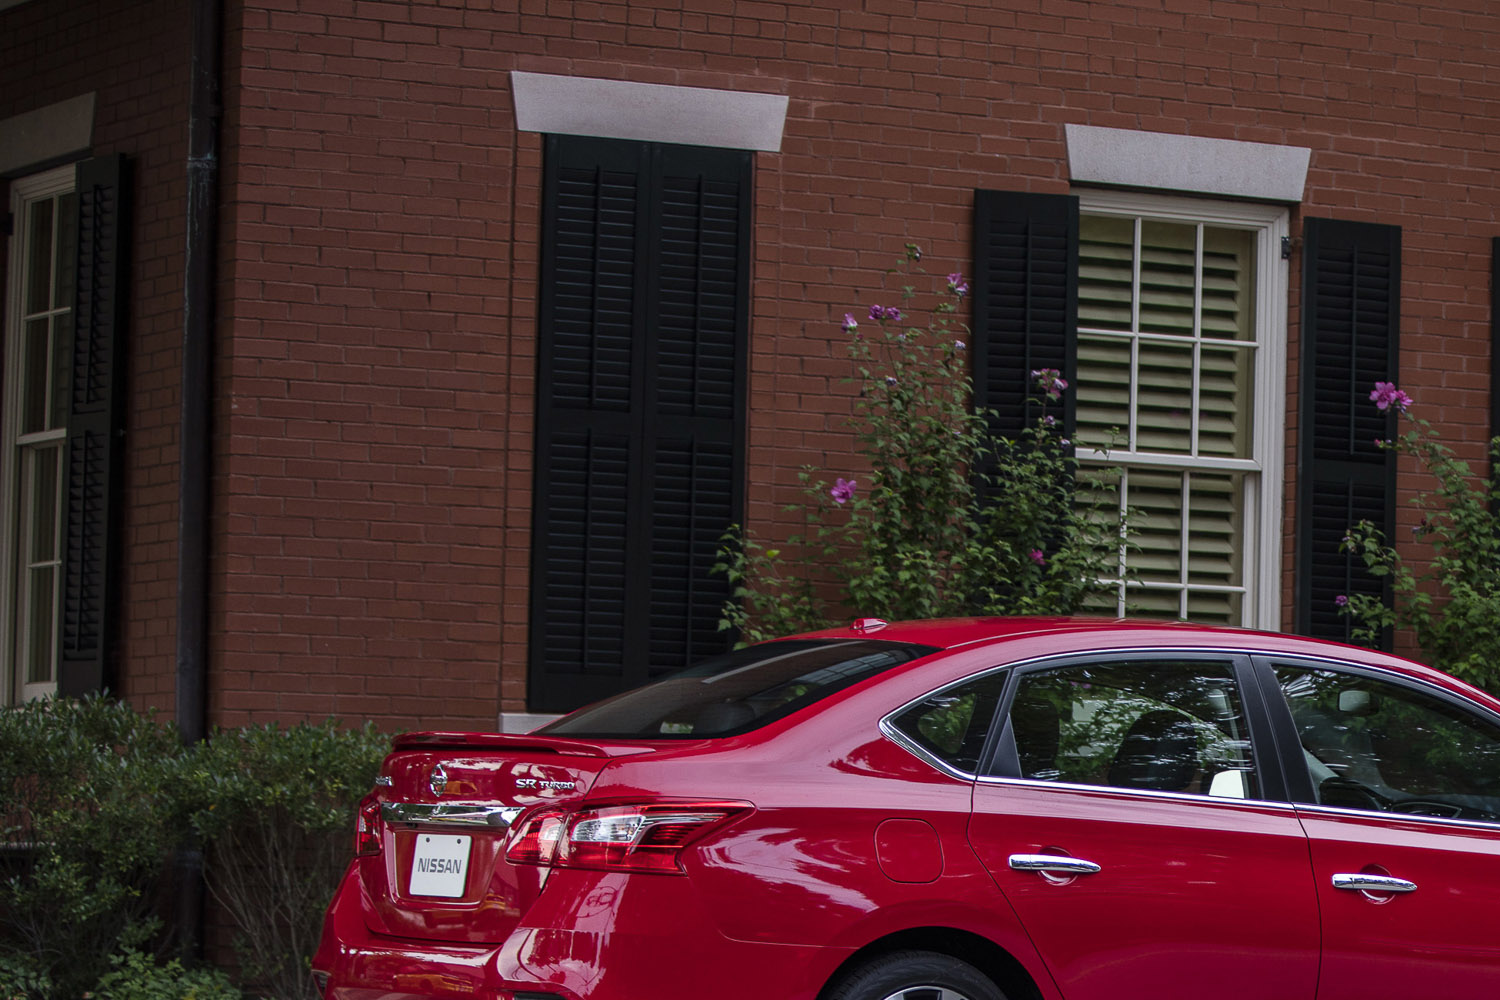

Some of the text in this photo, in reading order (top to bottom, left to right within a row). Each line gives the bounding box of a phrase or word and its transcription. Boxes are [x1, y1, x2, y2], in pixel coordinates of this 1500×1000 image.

[515, 778, 576, 790] SR TURBO
[417, 857, 462, 874] NISSAN
